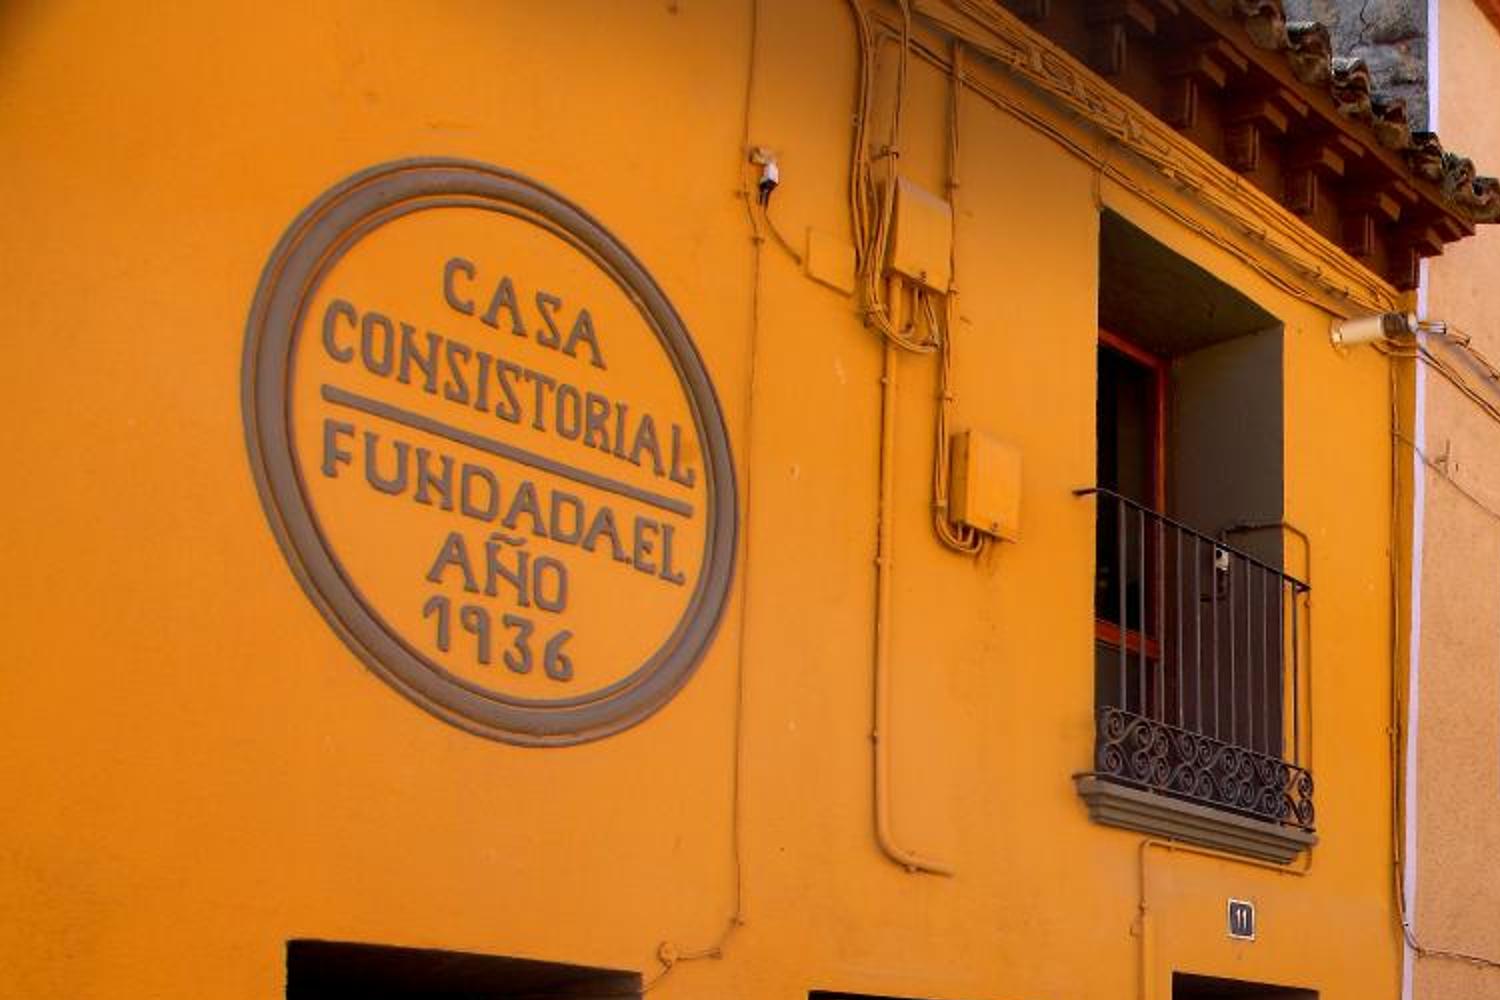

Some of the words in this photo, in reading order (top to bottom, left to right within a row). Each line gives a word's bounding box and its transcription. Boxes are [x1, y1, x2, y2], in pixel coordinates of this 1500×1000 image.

[443, 258, 607, 370] CASA
[320, 299, 695, 488] CONSISTORIAL
[426, 531, 568, 614] AÑO
[633, 515, 686, 587] EL
[422, 595, 574, 682] 1936
[1235, 909, 1247, 928] 11
